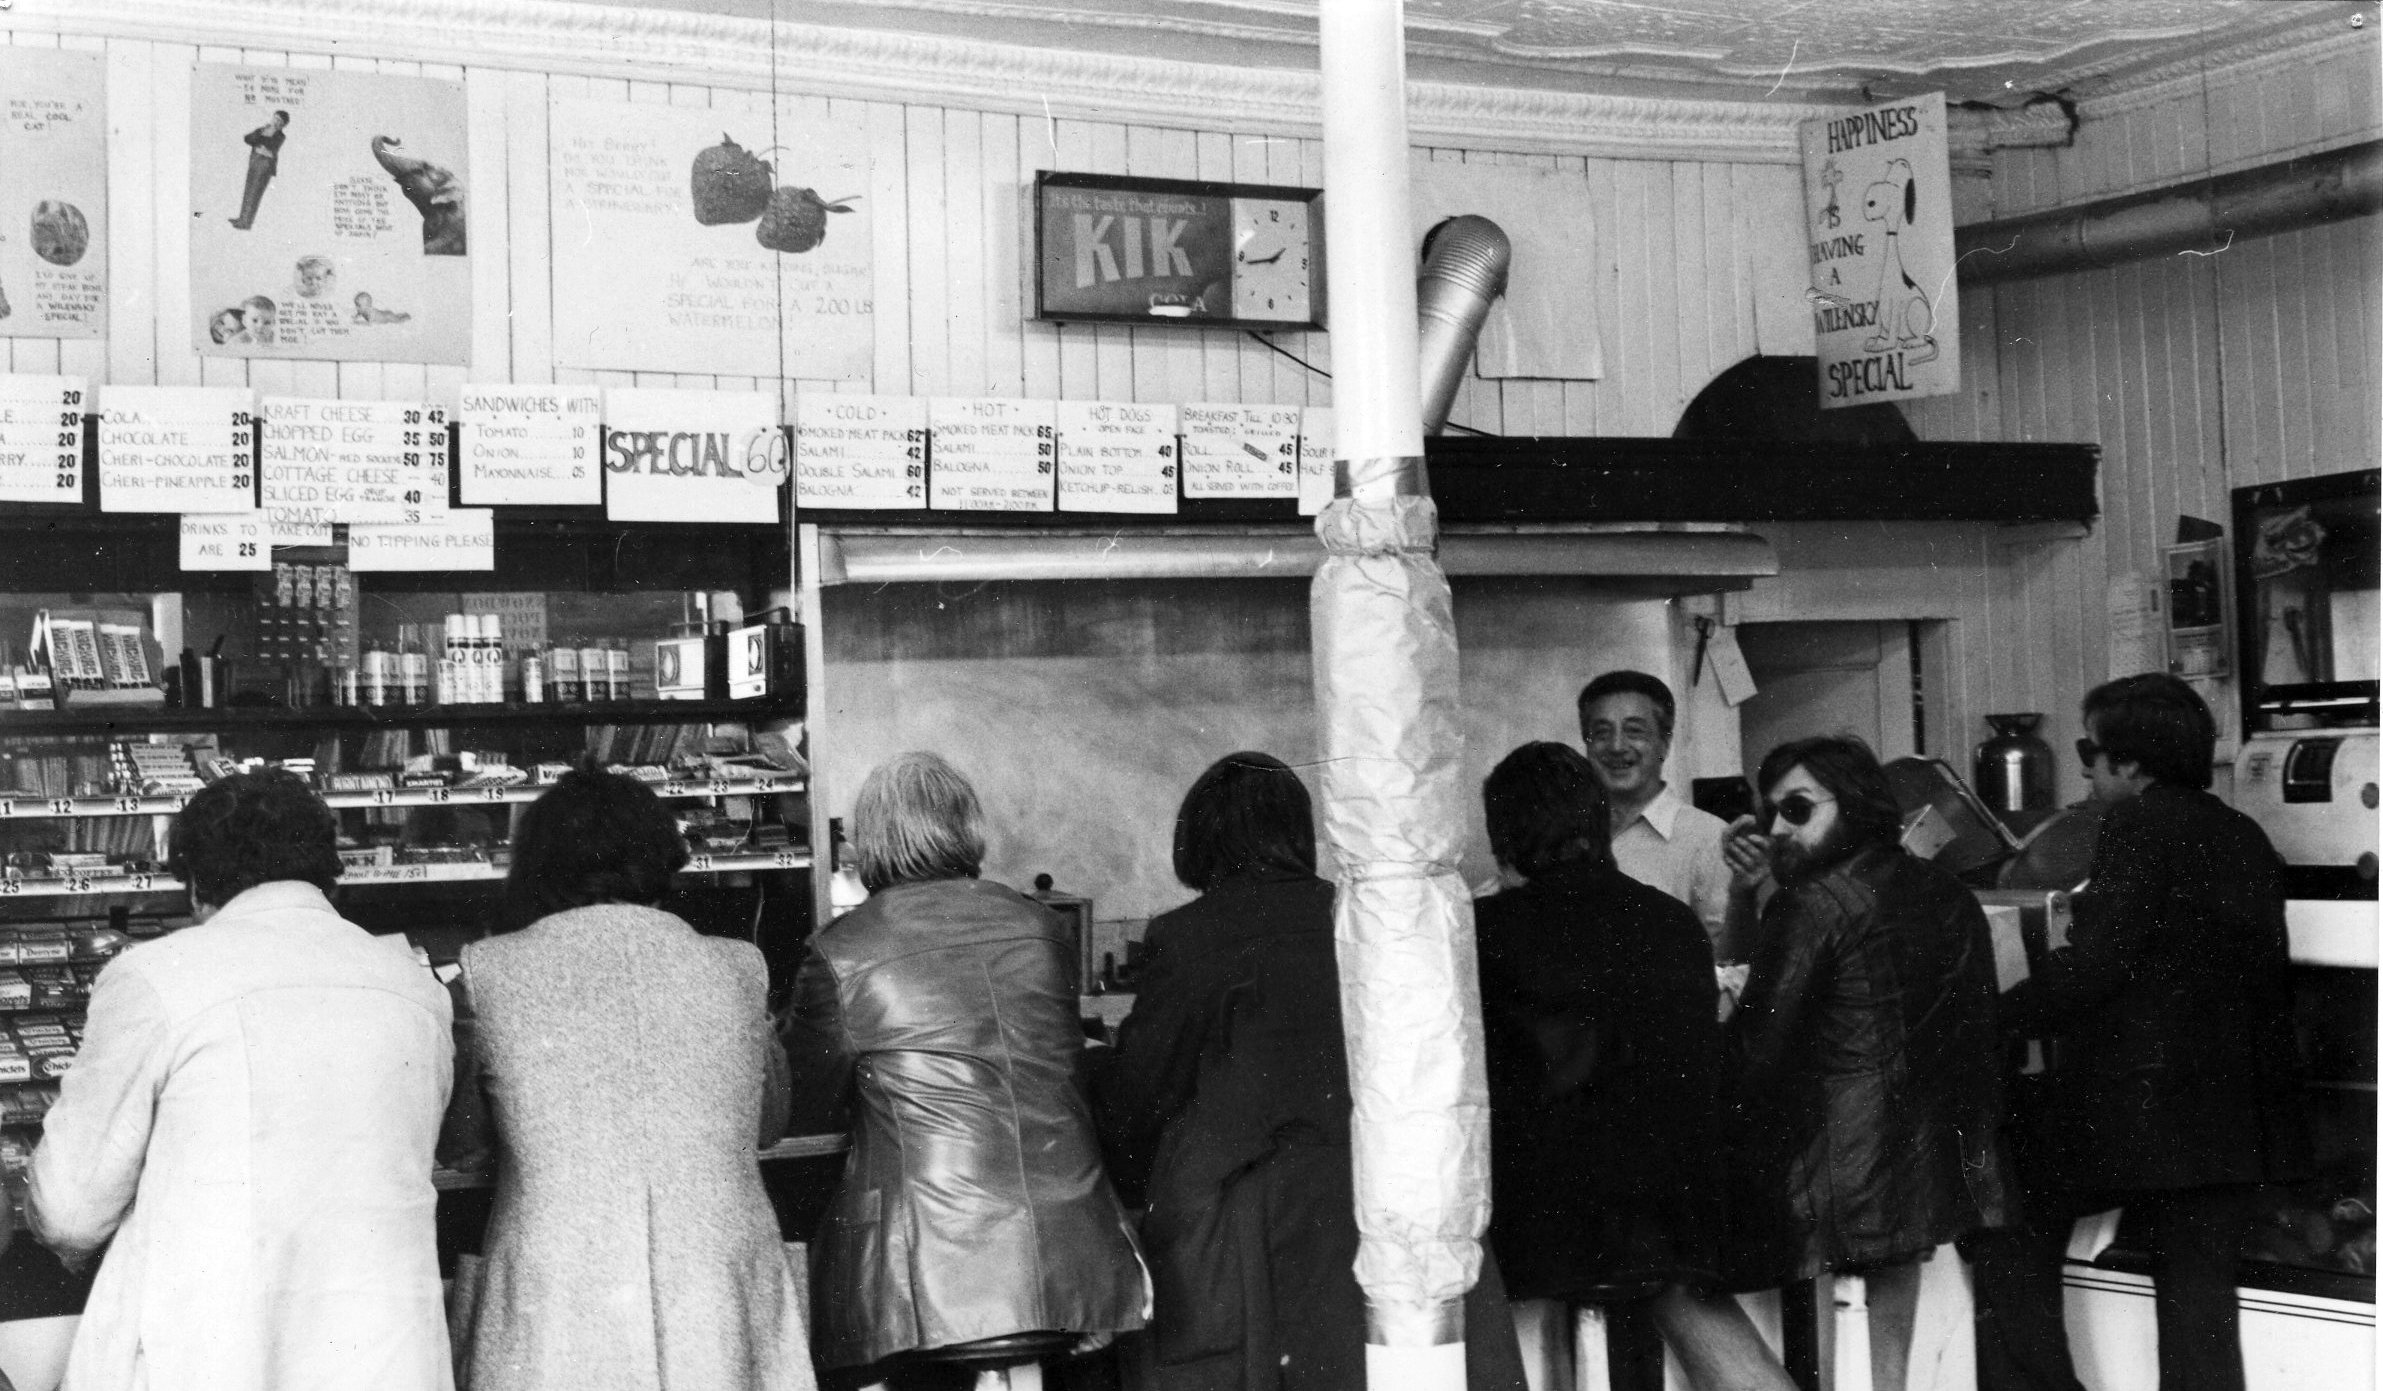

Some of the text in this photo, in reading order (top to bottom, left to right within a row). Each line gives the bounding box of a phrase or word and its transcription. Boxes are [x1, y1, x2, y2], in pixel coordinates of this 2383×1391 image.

[46, 113, 72, 122] COOL
[1827, 106, 1919, 154] HAPPINESS
[587, 181, 652, 196] SPECIAL
[1269, 209, 1279, 223] 12
[1828, 205, 1841, 229] IS
[1074, 213, 1195, 290] KIK
[1809, 233, 1867, 265] HAVING
[1300, 258, 1308, 271] 3
[1830, 267, 1842, 287] A
[667, 292, 734, 310] SPECIAL
[742, 297, 777, 311] FOR
[791, 298, 803, 312] A
[816, 296, 850, 316] 200
[1815, 300, 1880, 335] WILENSKY
[1828, 351, 1914, 399] SPECIAL
[63, 390, 81, 405] 20
[463, 396, 559, 413] SANDWICHES
[566, 397, 600, 414] WITH
[103, 408, 250, 427] COLA 20
[263, 404, 445, 425] KRAFT CHEESE 30 42
[836, 405, 877, 421] COLD
[972, 402, 1007, 417] HOT
[1089, 406, 1152, 422] HOT DOGS
[1184, 407, 1264, 423] BREAKFAST TILL
[60, 411, 79, 427] 20
[101, 428, 250, 447] CHOCOLATE 20
[263, 425, 446, 447] CHOPPED EGG 35 50
[475, 423, 586, 440] TOMATO 10
[799, 423, 845, 440] SMOKED
[848, 428, 880, 441] MEAT
[907, 429, 922, 443] 62
[933, 420, 1053, 439] SMOKED MEAT 65
[57, 432, 76, 447] 20
[473, 443, 586, 460] ONION 10
[606, 431, 787, 479] SPECIAL 60
[799, 443, 921, 460] SALAMI 42
[933, 439, 1052, 457] SALAMI 50
[1059, 442, 1173, 459] PLAIN BOTTOM 40
[1183, 442, 1212, 456] ROLL
[1278, 442, 1294, 457] 45
[57, 454, 77, 469] 20
[232, 453, 250, 468] 20
[403, 452, 420, 467] 50
[428, 452, 446, 467] 75
[933, 459, 1052, 475] BALOGNA 50
[474, 463, 554, 479] MAYONNAISE
[798, 462, 921, 479] DOUBLE SALAMI 60
[1059, 461, 1176, 479] ONION TOP 45
[1183, 460, 1294, 476] ONION ROLL 45
[56, 473, 76, 489] 20
[231, 474, 250, 489] 20
[263, 466, 446, 487] COTTAGE CHEESE 40
[263, 485, 421, 504] SLICED EGG 40
[798, 482, 921, 498] BALOGNA 42
[941, 487, 1049, 499] NOT SERVED BETWEEN
[1191, 482, 1295, 492] ALL SERVED WITH COFFEE
[404, 509, 420, 523] 35
[181, 524, 228, 536] DRINKS
[239, 525, 257, 536] TO
[269, 524, 301, 536] TAKE
[350, 534, 494, 548] NO TIPPING PLEASE
[198, 543, 257, 557] ARE 25
